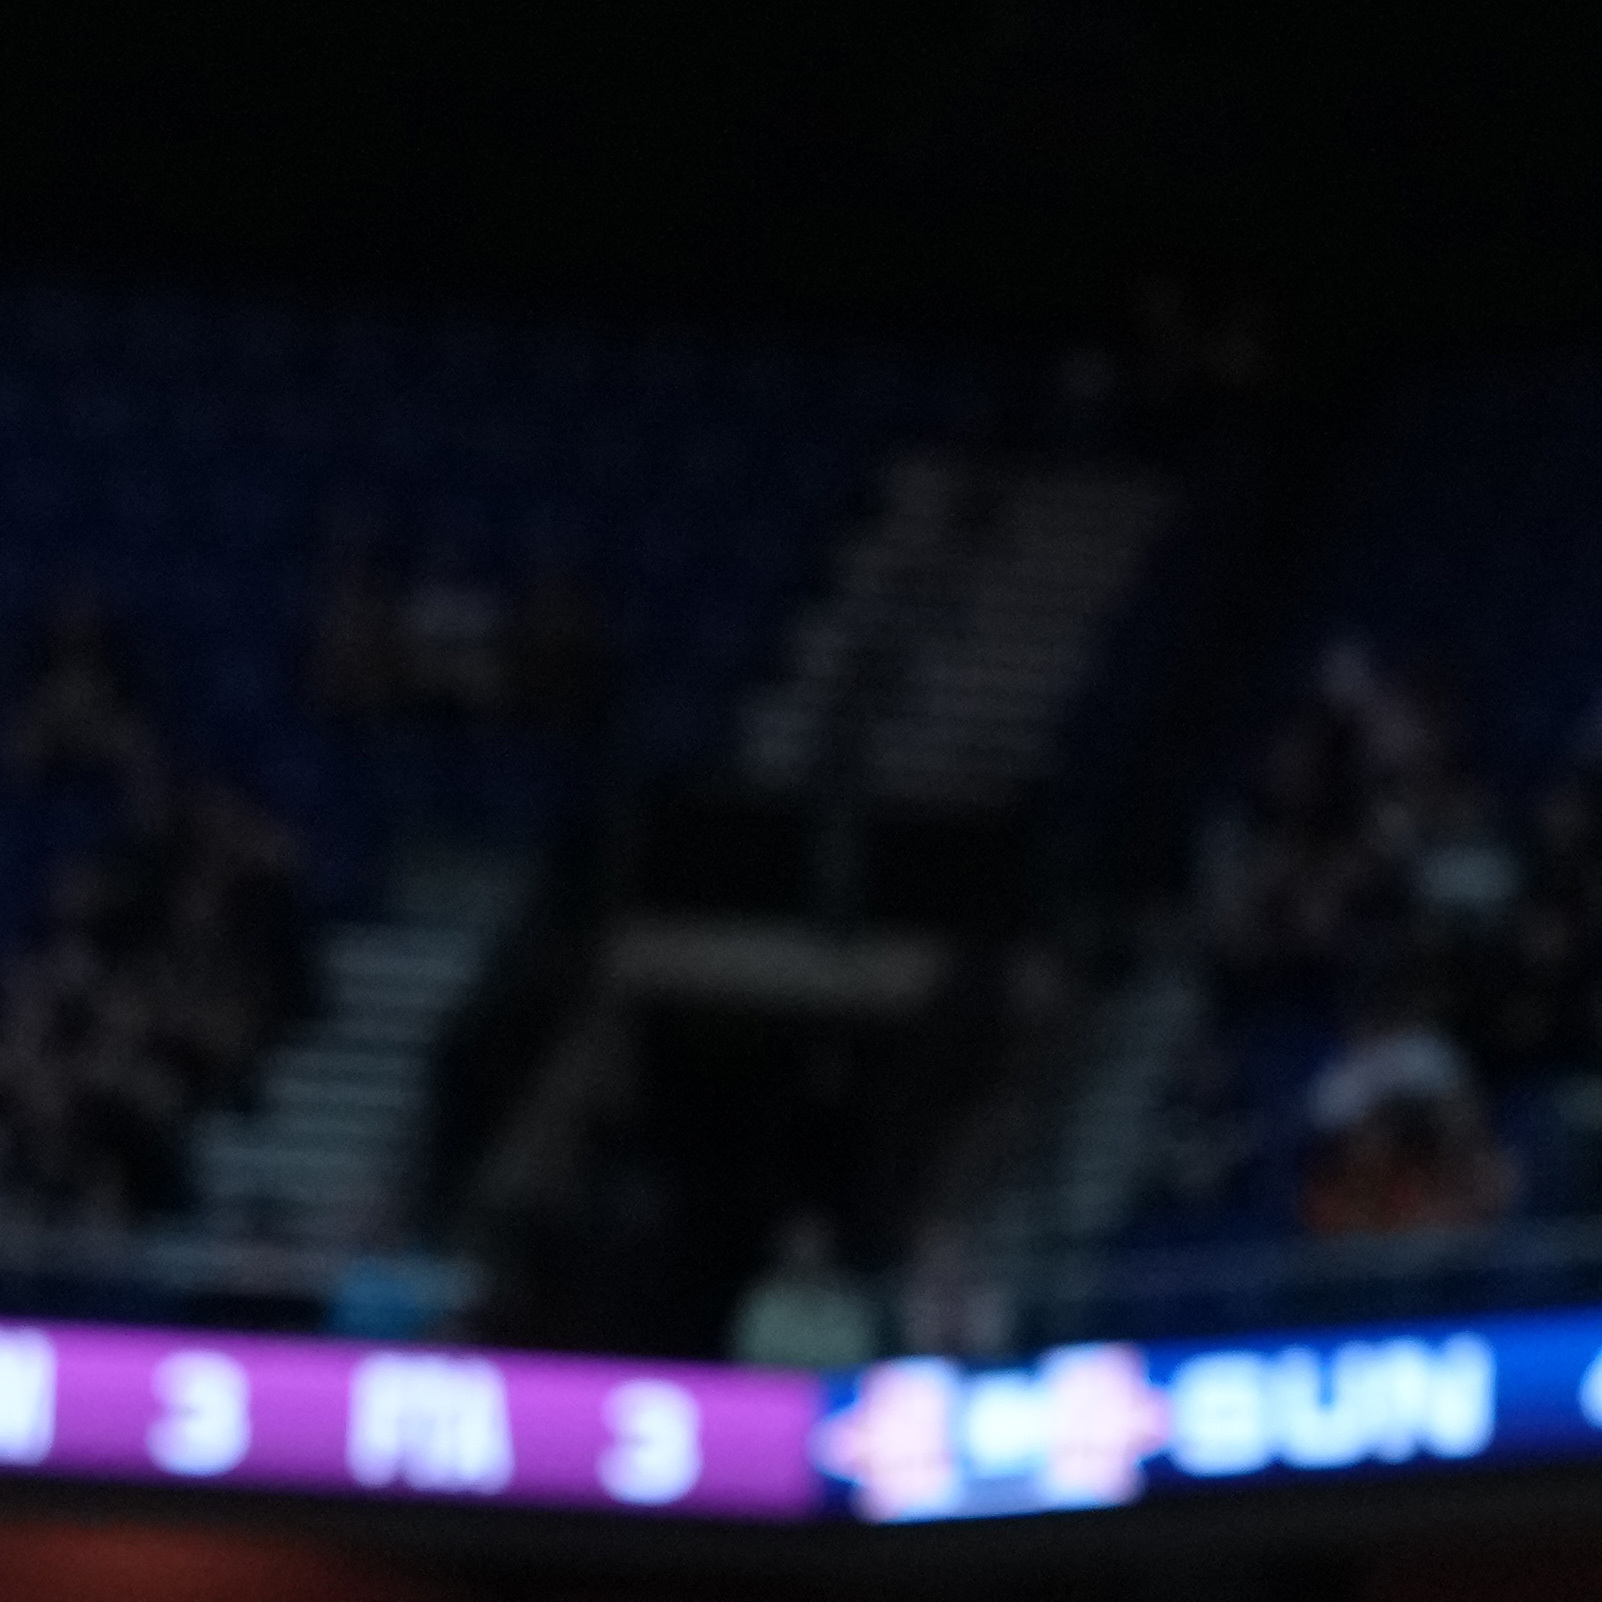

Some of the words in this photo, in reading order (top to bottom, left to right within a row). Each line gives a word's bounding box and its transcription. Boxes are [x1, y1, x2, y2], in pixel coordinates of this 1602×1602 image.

[146, 1350, 251, 1476] 3
[596, 1377, 703, 1506] 3
[1171, 1331, 1494, 1475] SUN
